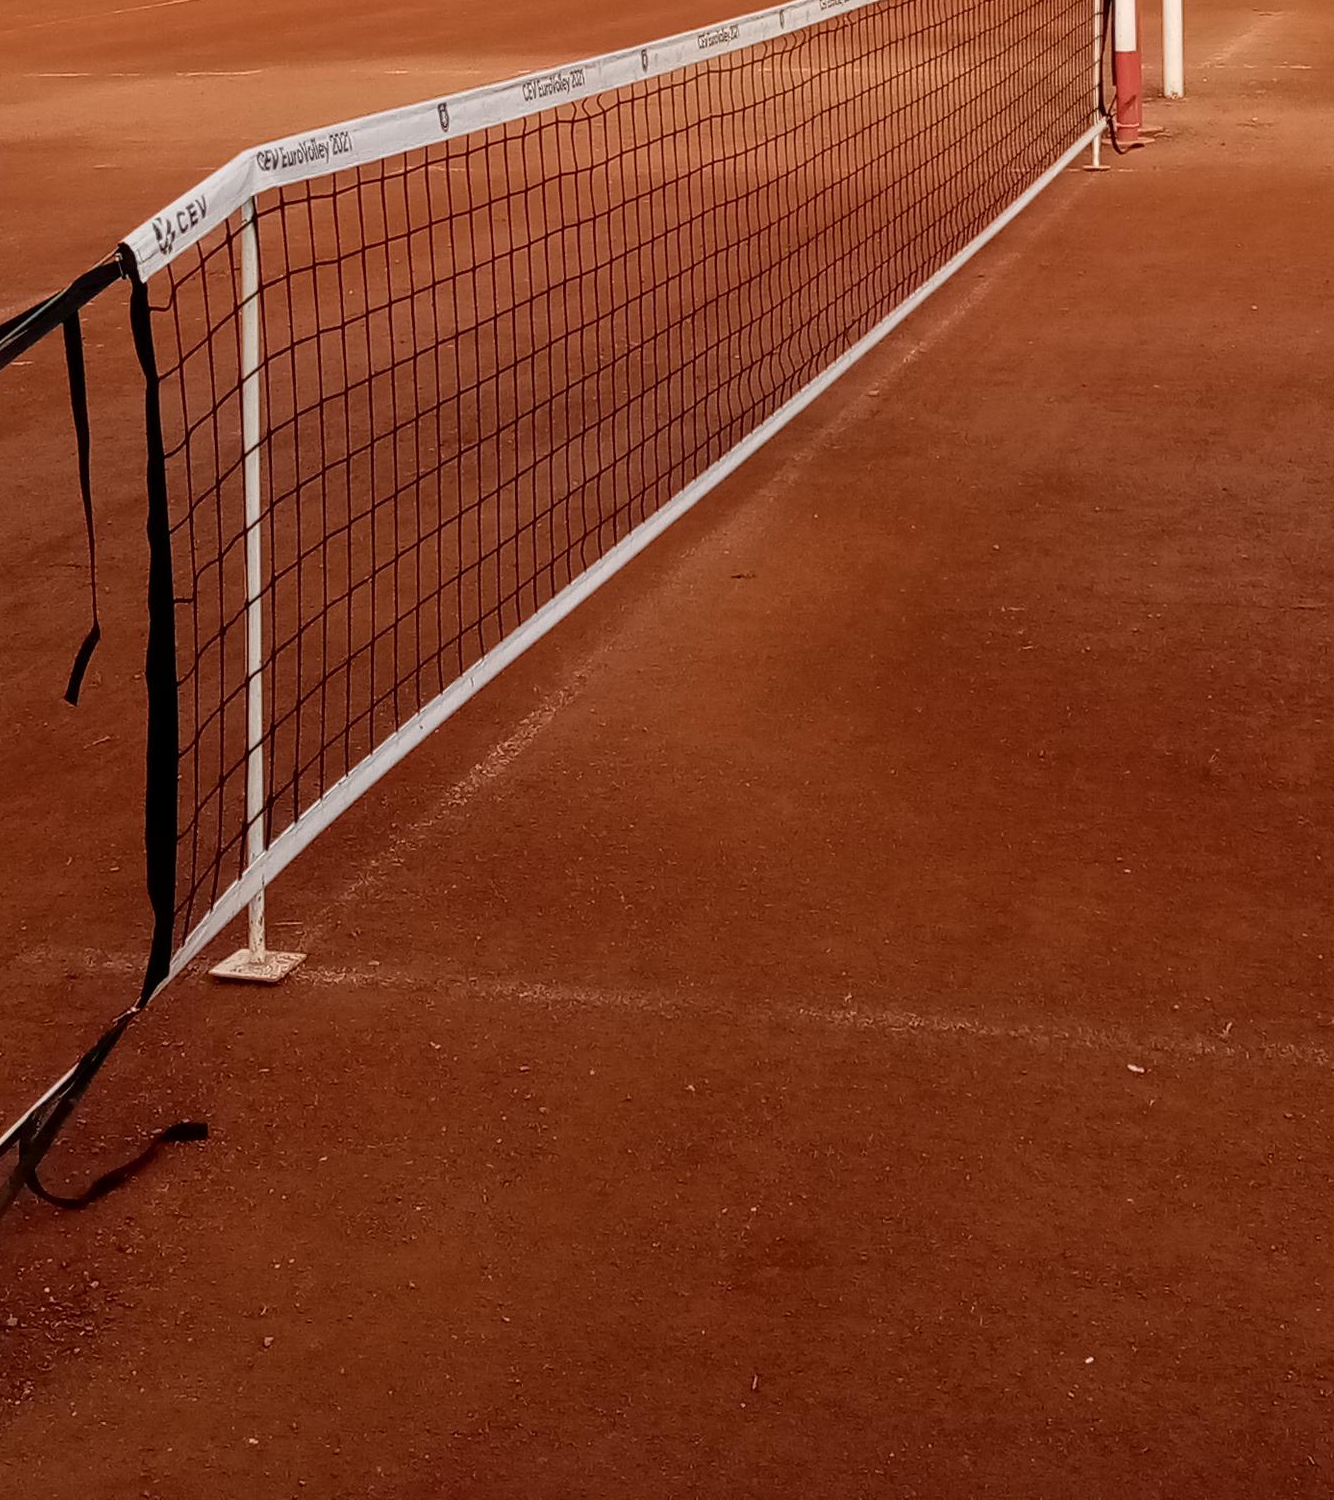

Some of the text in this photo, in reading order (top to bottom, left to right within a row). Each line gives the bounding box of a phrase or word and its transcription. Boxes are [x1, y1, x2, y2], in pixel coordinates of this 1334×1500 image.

[256, 131, 353, 171] CEV EuroVolley 2021
[176, 195, 207, 234] CEV
